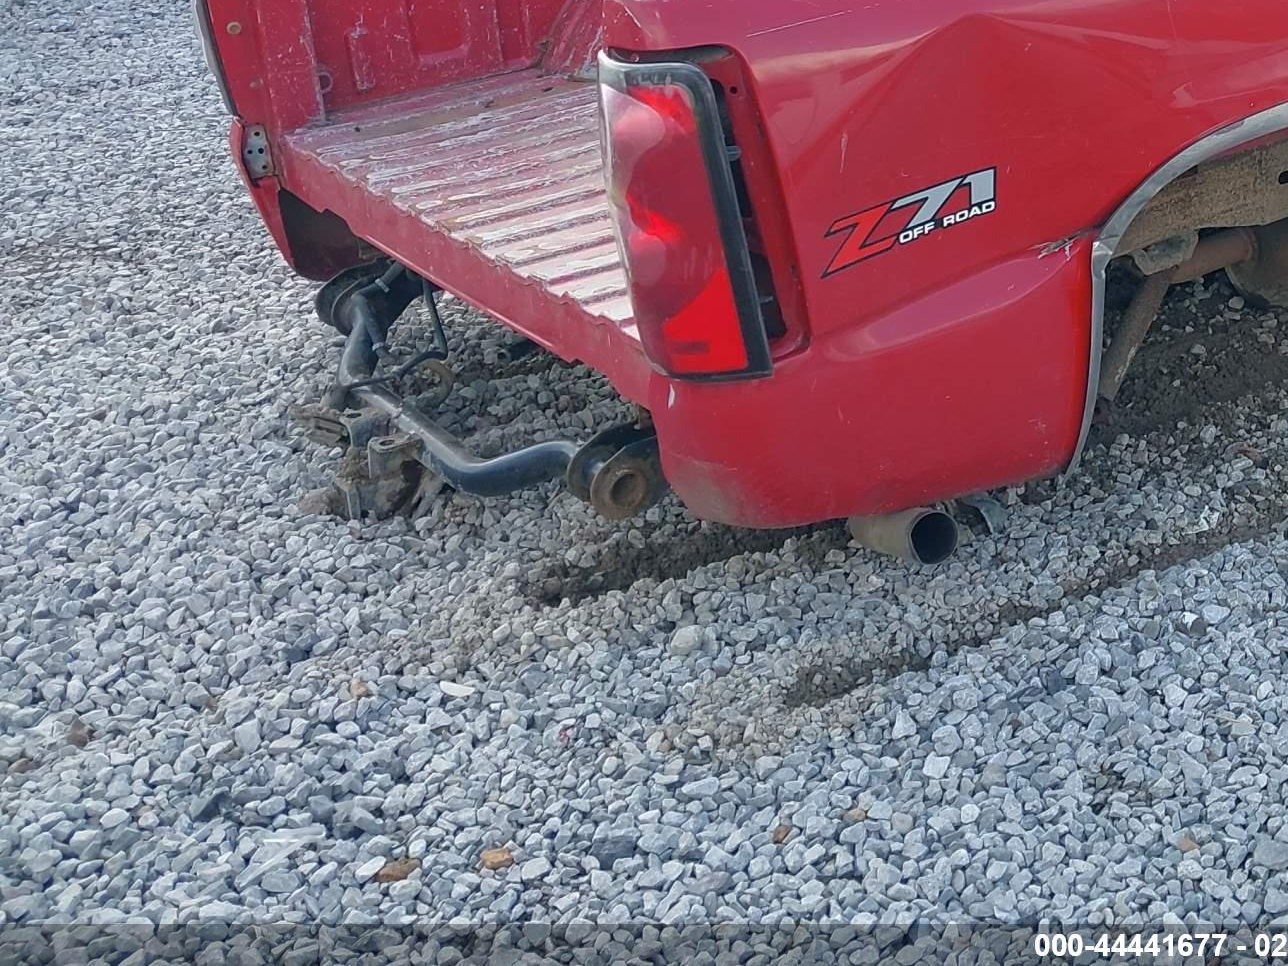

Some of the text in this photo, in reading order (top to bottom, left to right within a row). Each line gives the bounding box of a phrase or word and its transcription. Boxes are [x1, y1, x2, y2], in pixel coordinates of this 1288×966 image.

[820, 166, 997, 279] Z71
[898, 200, 997, 245] OFF ROAD
